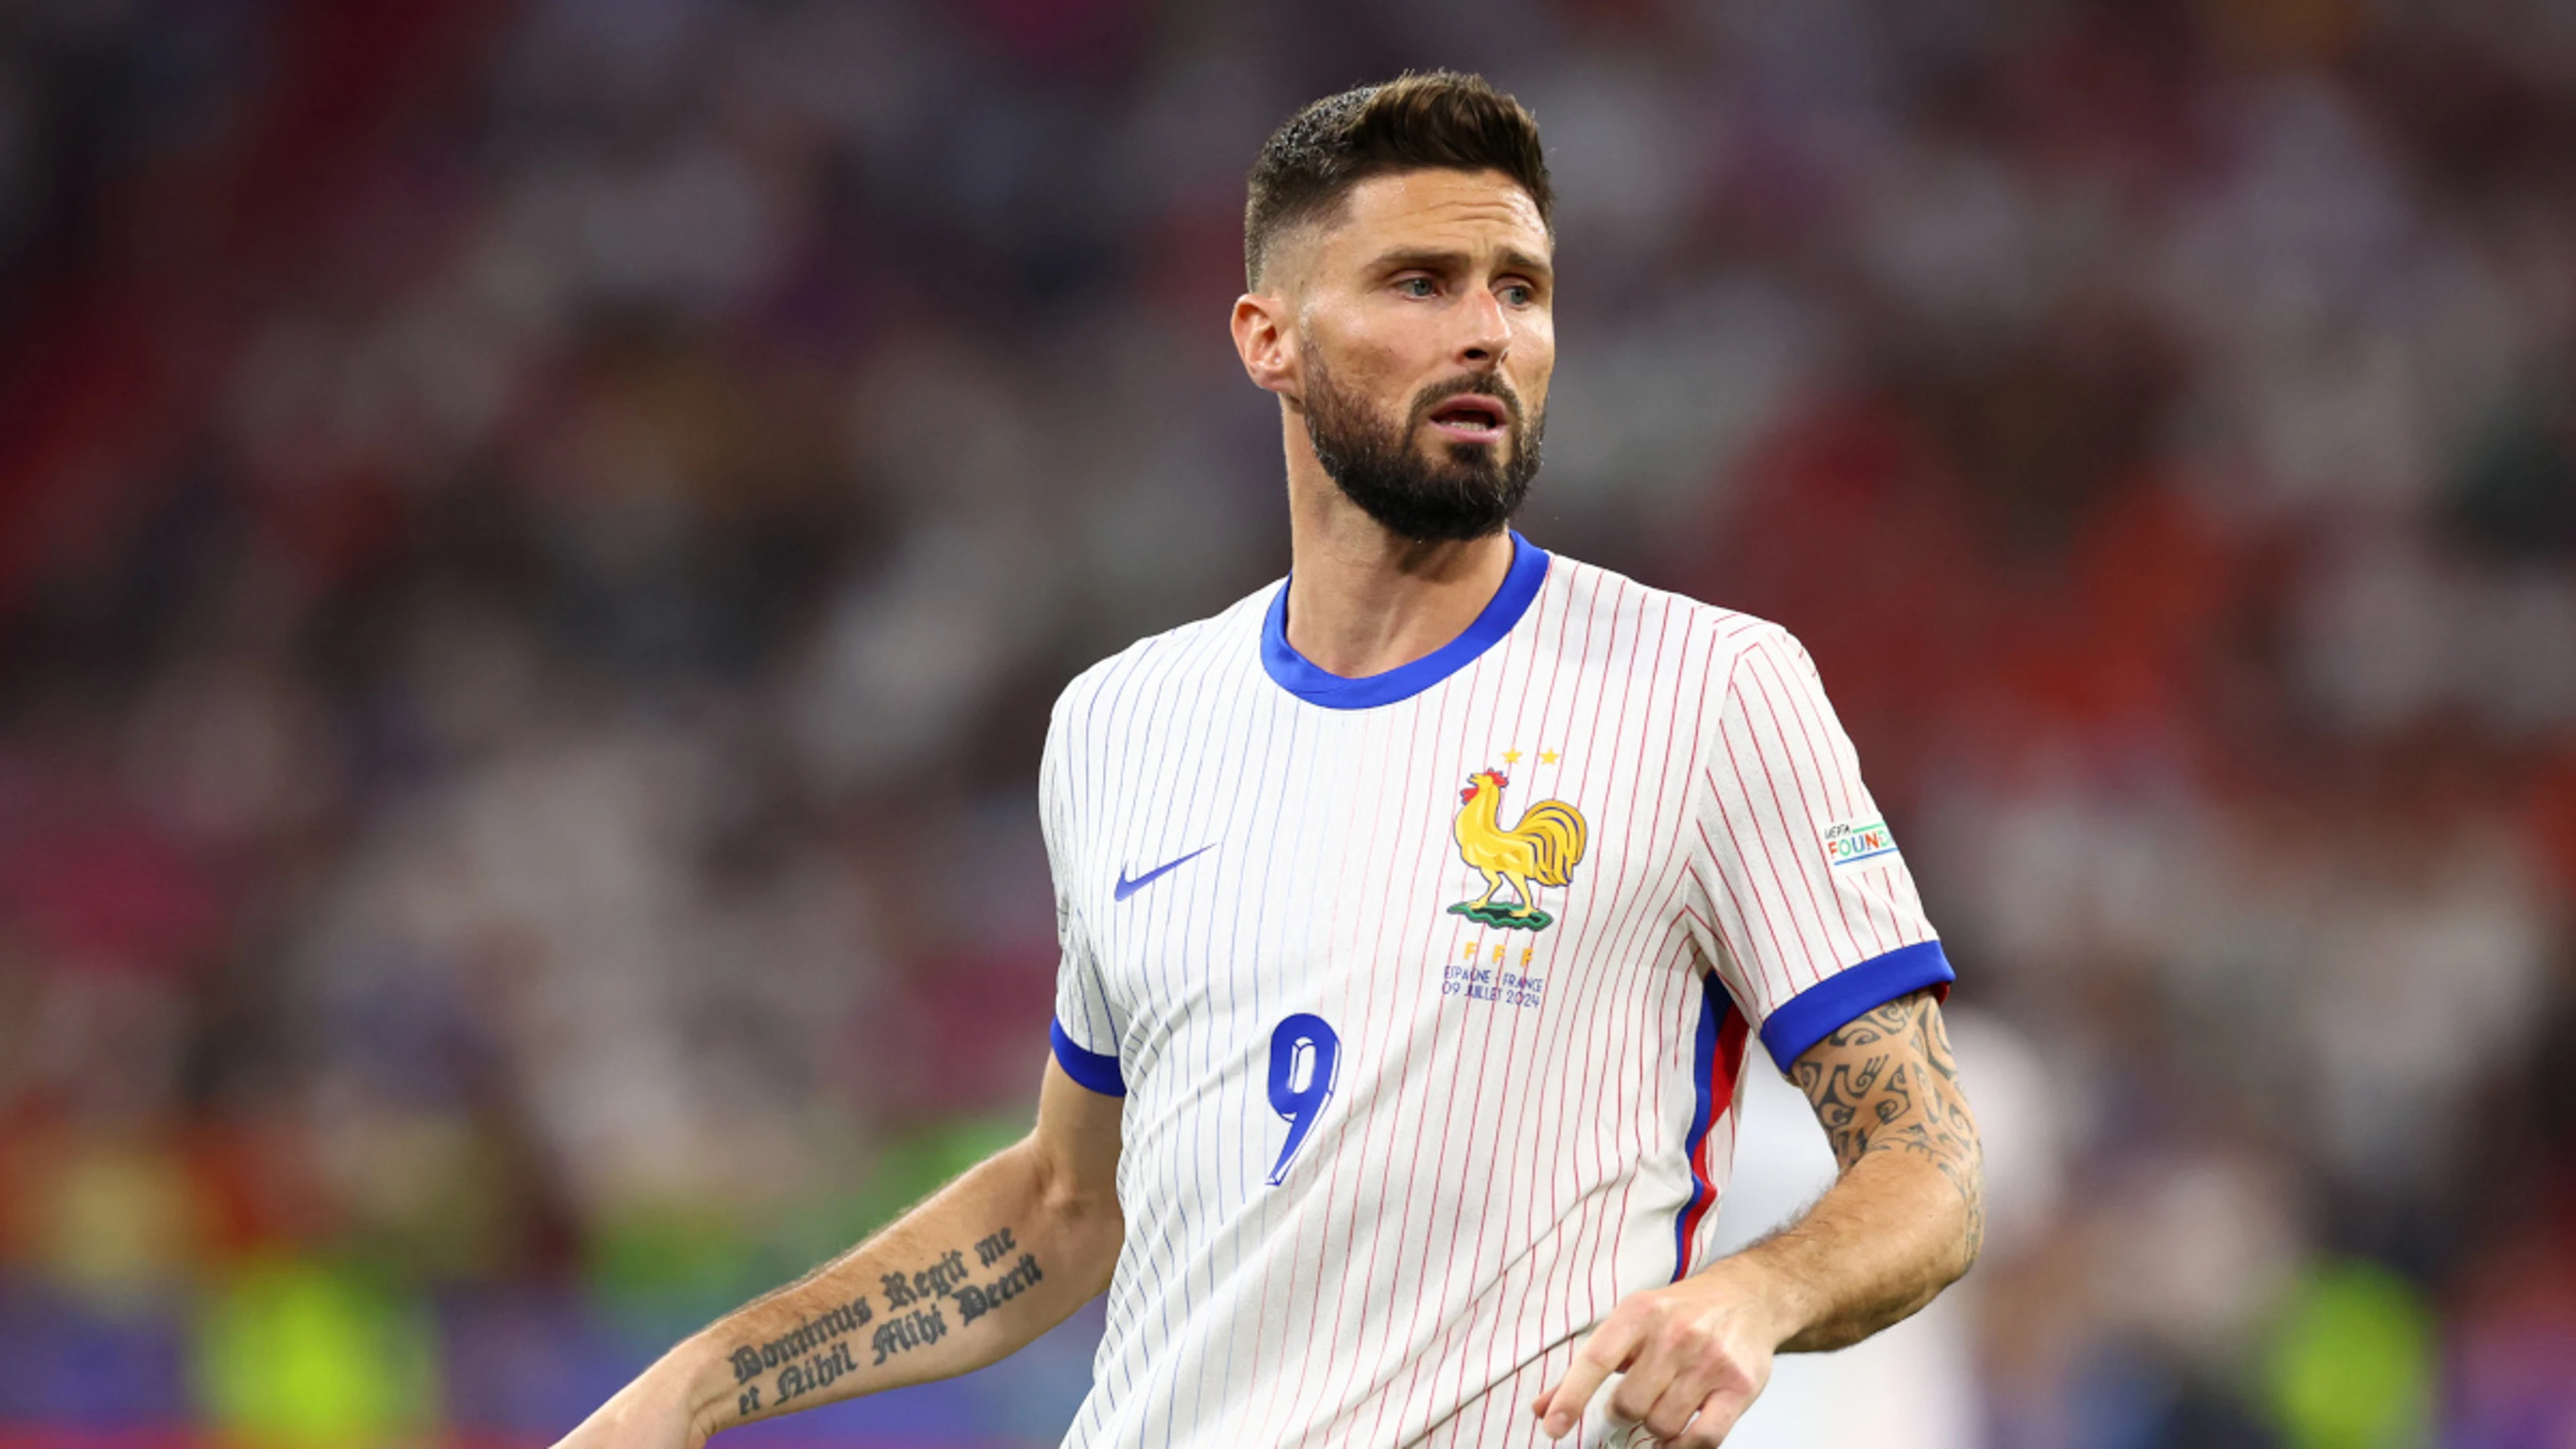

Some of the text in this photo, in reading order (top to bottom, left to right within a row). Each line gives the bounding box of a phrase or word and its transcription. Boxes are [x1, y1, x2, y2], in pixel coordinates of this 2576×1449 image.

[1825, 824, 1851, 839] UEFA
[1442, 981, 1540, 1008] 09 JUILLET 2024
[1503, 973, 1543, 992] FRANCE
[1266, 1013, 1342, 1187] 9
[727, 1228, 1016, 1384] Dominus Regit me
[739, 1252, 1043, 1415] et Nihil Mihi Deerit
